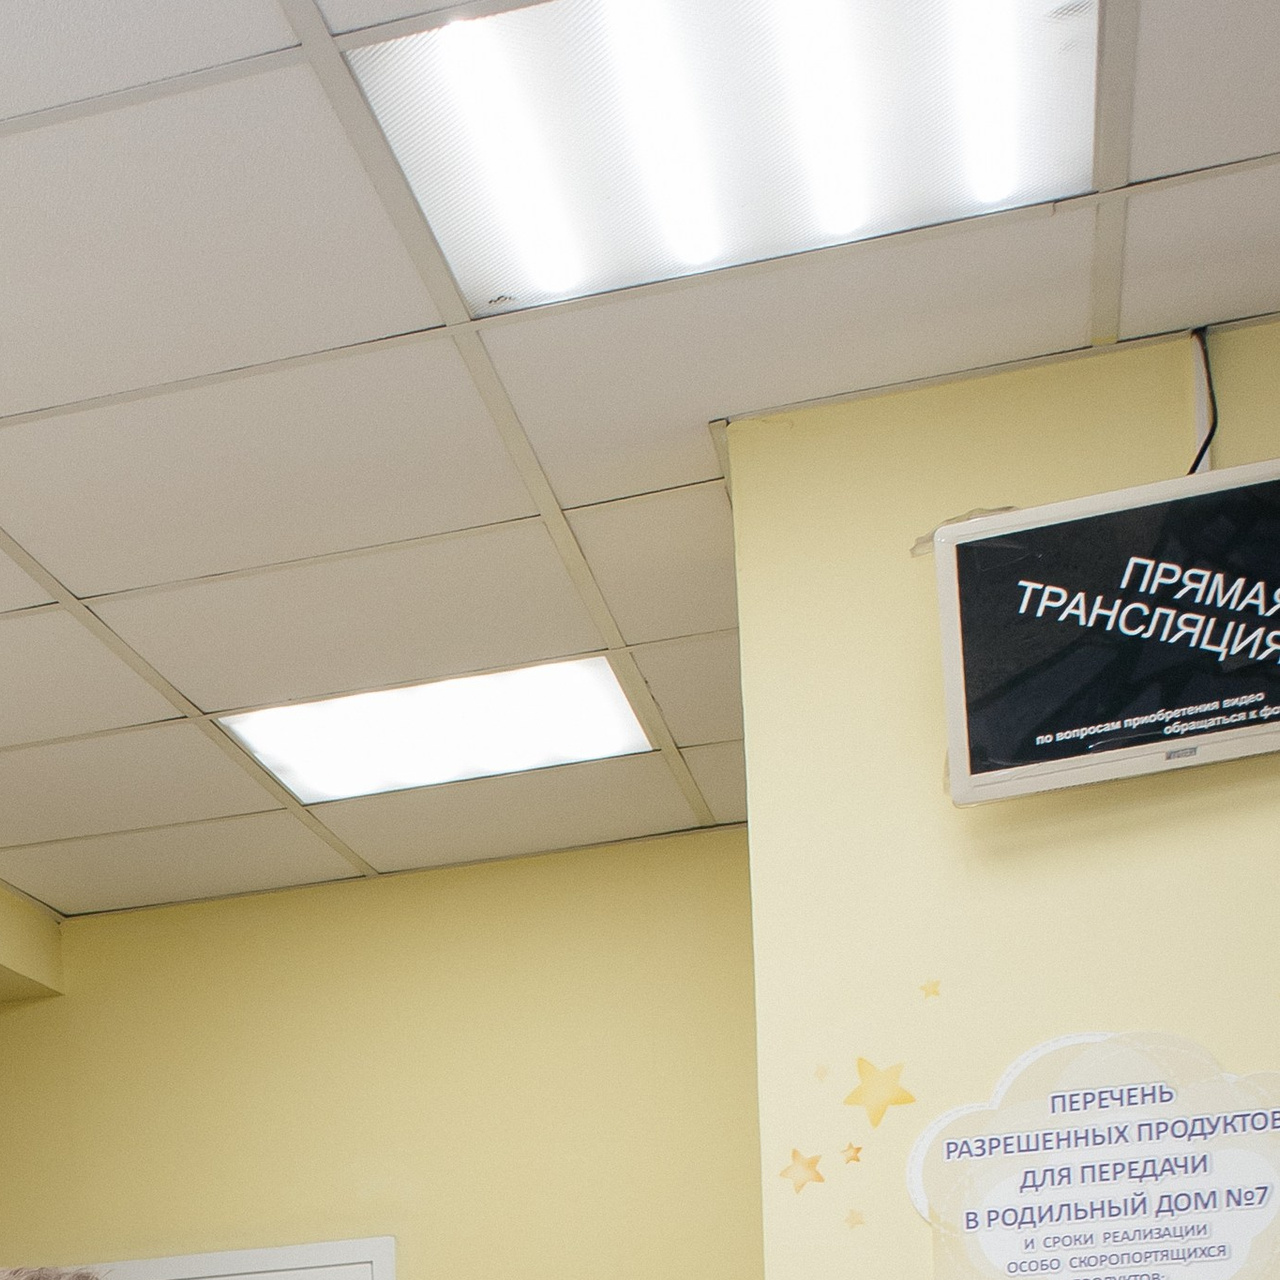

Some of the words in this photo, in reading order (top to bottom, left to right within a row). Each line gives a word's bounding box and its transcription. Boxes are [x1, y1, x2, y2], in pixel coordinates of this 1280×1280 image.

[1035, 733, 1054, 745] по
[1055, 720, 1121, 742] вопросам
[1123, 700, 1219, 729] приобретения
[1222, 692, 1265, 710] видео
[1163, 711, 1247, 735] обращаться
[1249, 709, 1258, 720] к
[1051, 1085, 1174, 1113] ПЕРЕЧЕНЬ
[946, 1124, 1129, 1159] РАЗРЕШЕННЫХ
[1137, 1110, 1280, 1141] ПРОДУКТОВ
[1020, 1167, 1071, 1193] ДЛЯ
[1080, 1154, 1208, 1183] ПЕРЕДАЧИ
[965, 1212, 979, 1229] В
[987, 1192, 1147, 1229] РОДИЛЬНЫЙ
[1155, 1190, 1217, 1218] ДОМ
[1226, 1186, 1269, 1208] №7
[1024, 1238, 1035, 1250] И
[1043, 1234, 1094, 1248] СРОКИ
[1102, 1224, 1207, 1243] РЕАЛИЗАЦИИ
[1007, 1258, 1061, 1273] ОСОБО
[1069, 1245, 1226, 1268] СКОРОПОРТЯЩИХСЯ
